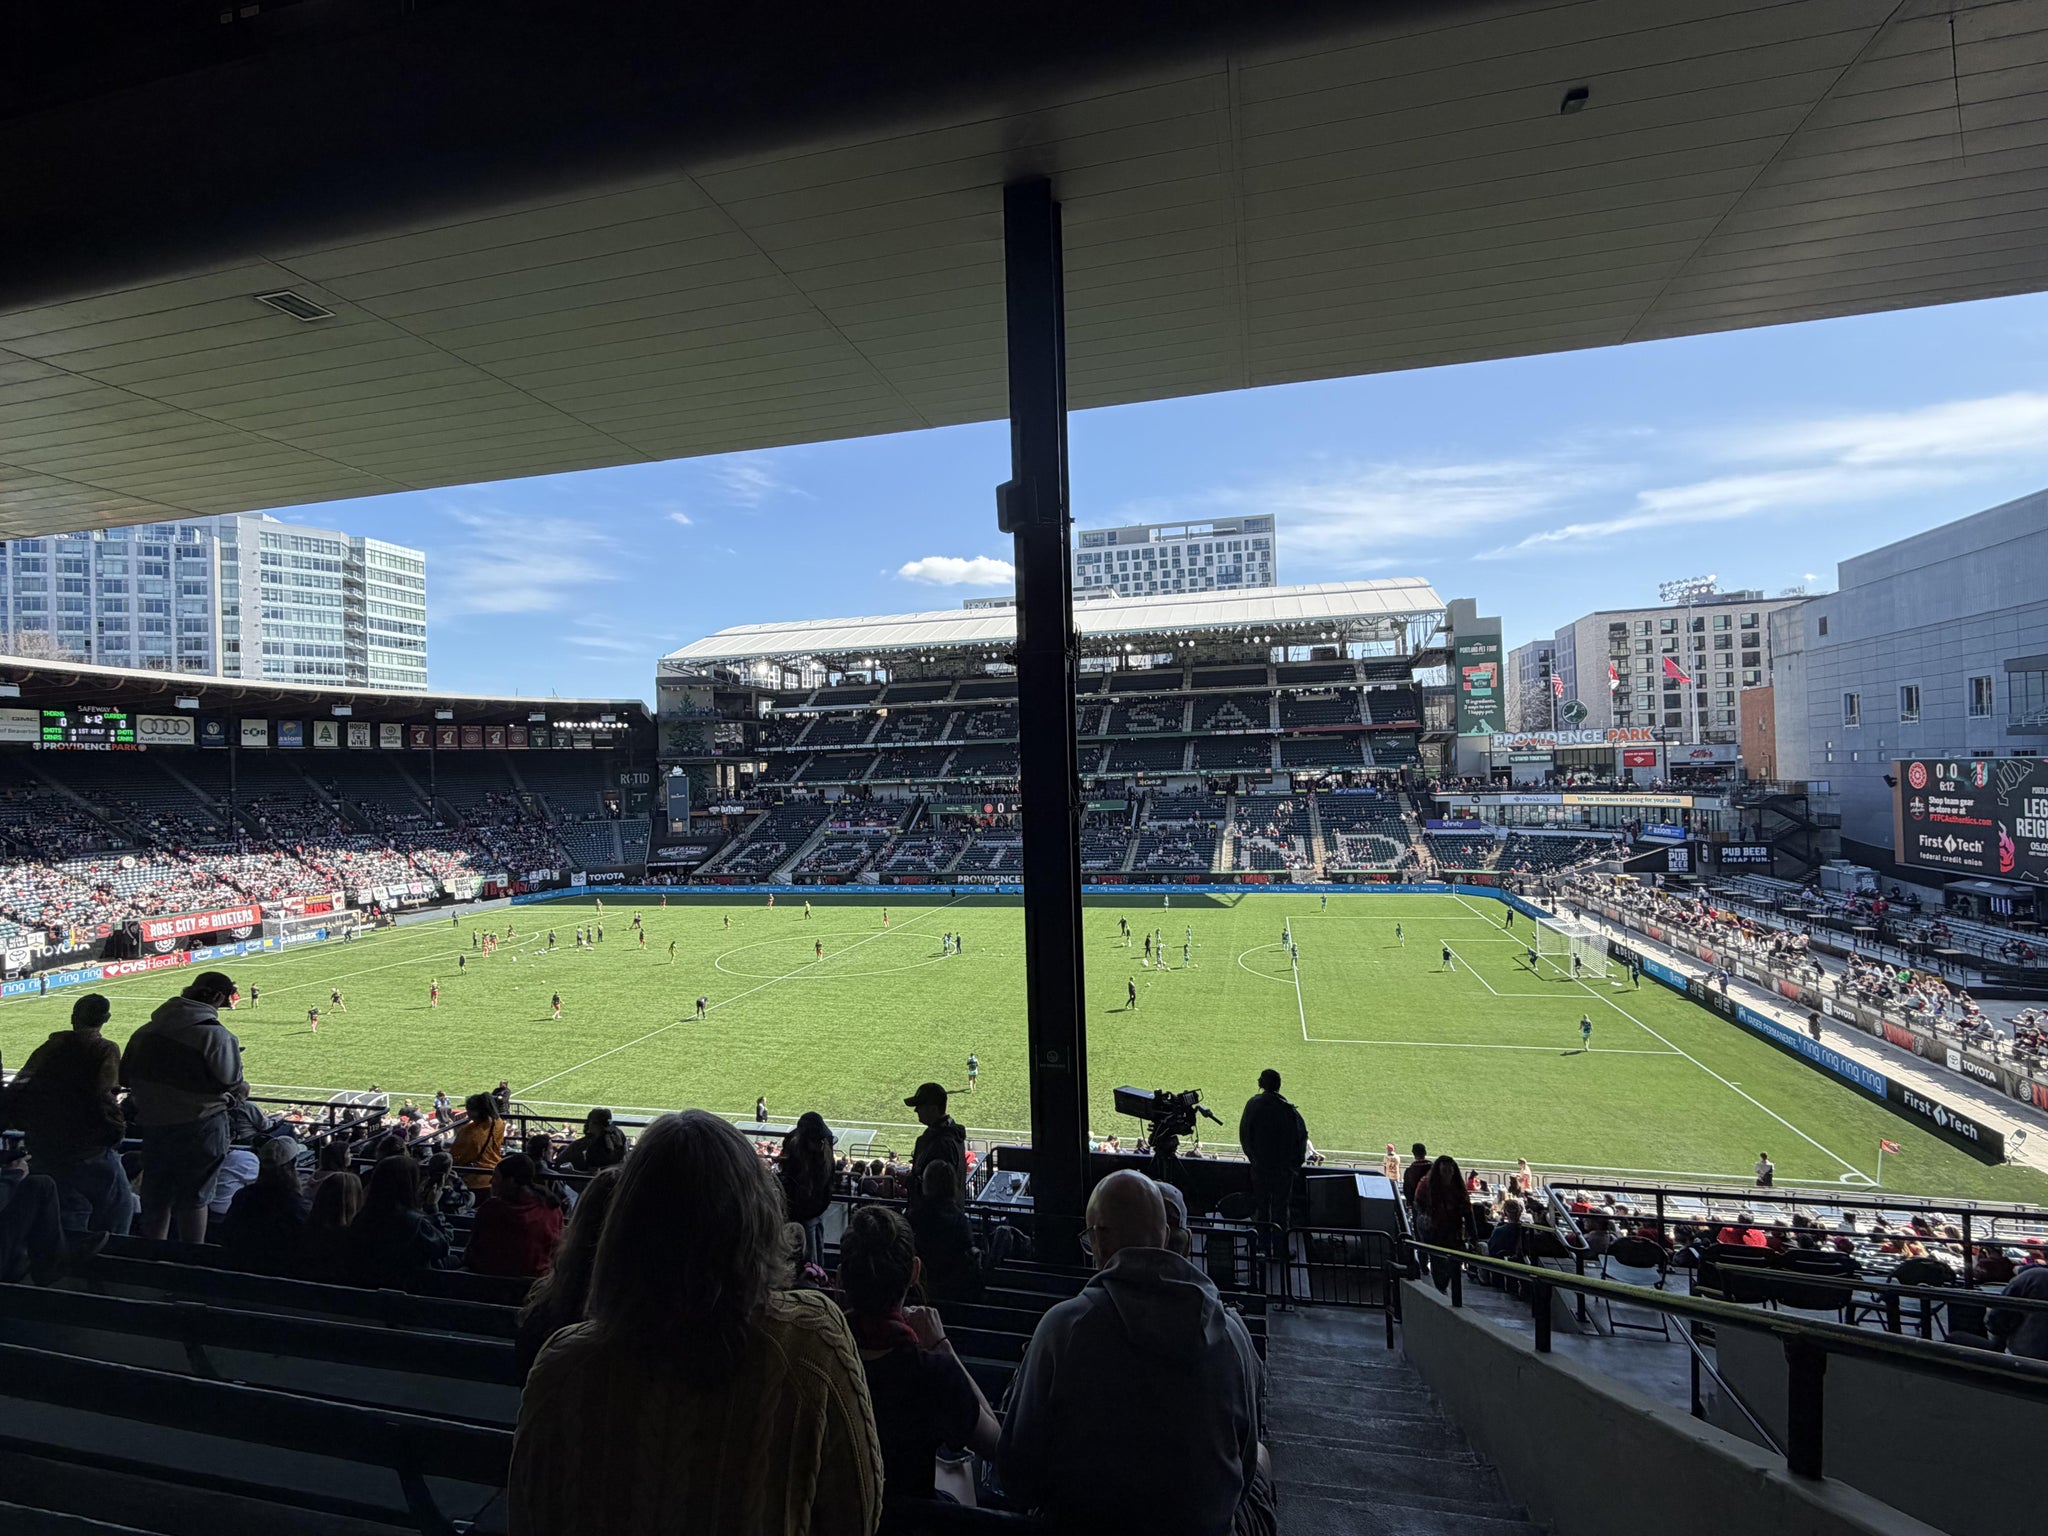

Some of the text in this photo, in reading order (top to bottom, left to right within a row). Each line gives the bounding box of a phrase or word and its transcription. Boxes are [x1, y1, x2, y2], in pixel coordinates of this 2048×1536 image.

[60, 718, 67, 727] 0
[120, 720, 126, 728] 0
[1492, 726, 1656, 747] PROVIDENCE PARK
[43, 742, 137, 751] PROVIDENCE PARK
[1936, 763, 1957, 778] 0 0
[1940, 782, 1954, 792] 6:12
[998, 803, 1004, 813] 0
[1929, 796, 1974, 807] Shop team gear
[1928, 805, 1950, 814] in-store
[1930, 814, 1992, 826] PTFCAuthentics.com
[1920, 834, 1983, 852] First Tech
[1668, 852, 1688, 860] PUB
[1722, 847, 1767, 856] PUB BEER
[1920, 852, 1982, 866] federal credit union
[588, 872, 625, 882] TOYOTA
[1184, 875, 1200, 884] 2012
[150, 909, 254, 937] ROSE CITY RIVETERS
[194, 950, 212, 958] prime
[220, 944, 237, 952] prime
[120, 957, 178, 974] CVS Healt
[4, 982, 25, 993] ring
[59, 972, 80, 984] ring
[82, 968, 102, 978] ring
[1832, 1005, 1856, 1022] TOYOTA
[1747, 1014, 1762, 1030] KAISER
[1803, 1040, 1881, 1093] ring ring ring ring
[1962, 1059, 1997, 1082] TOYOTA
[1904, 1090, 1978, 1140] First Tech
